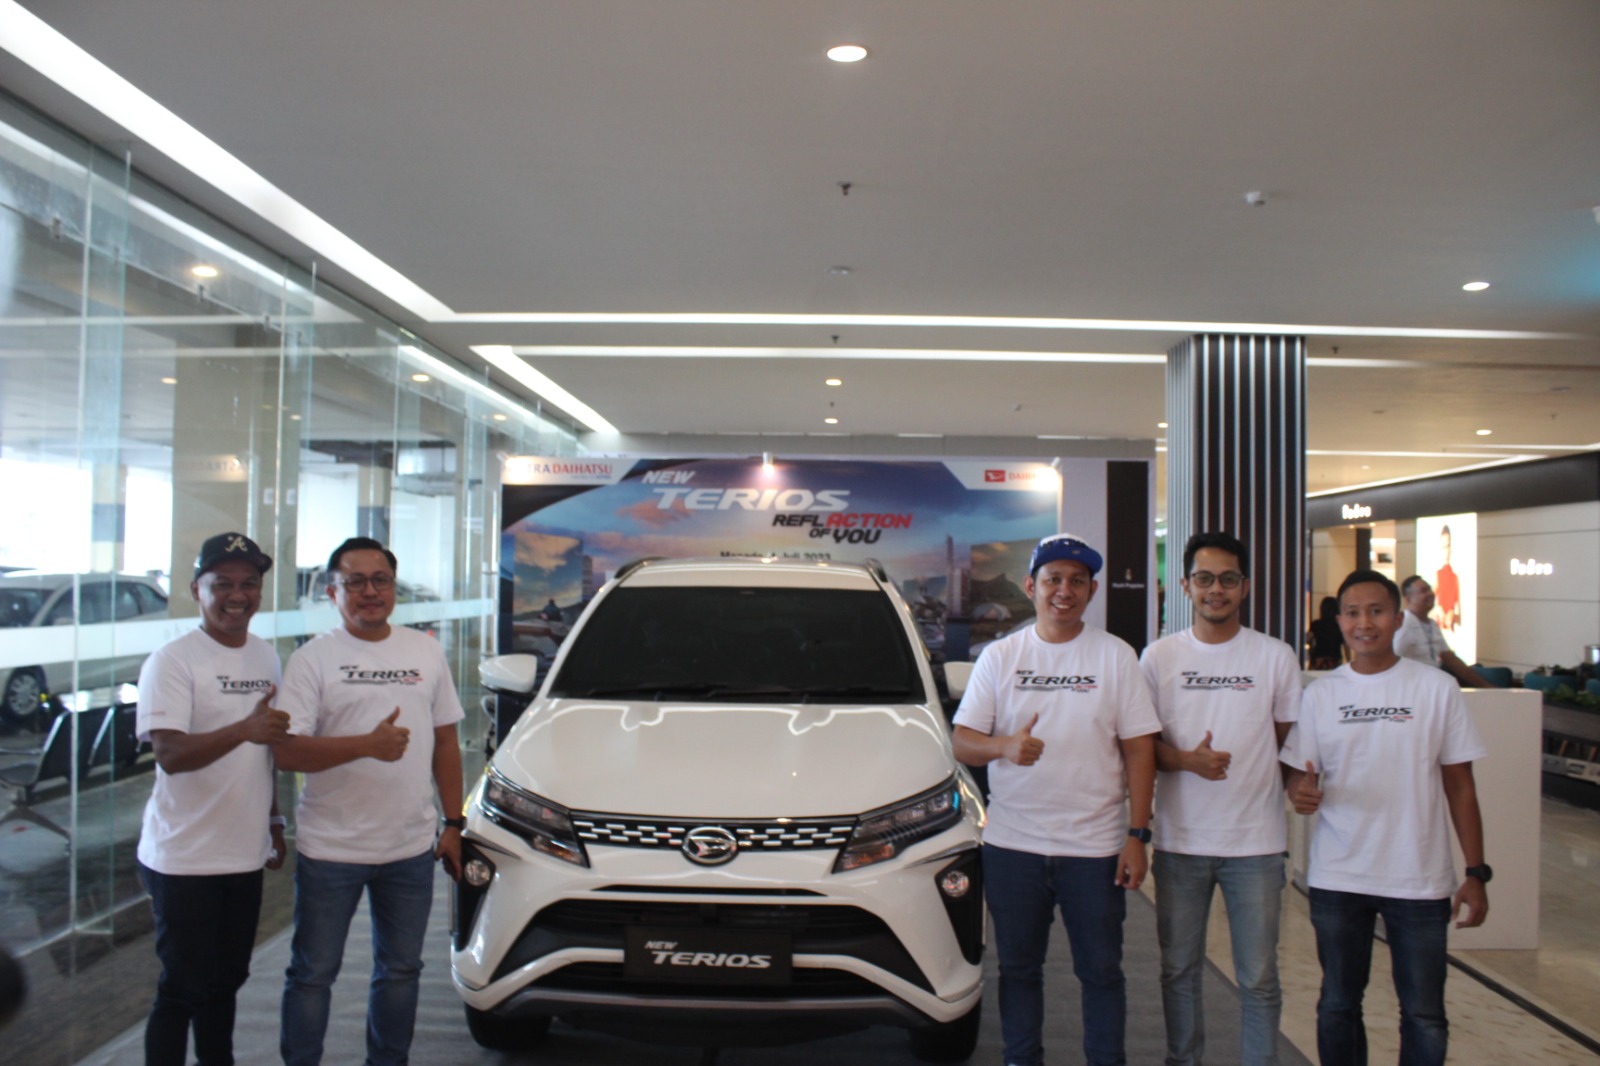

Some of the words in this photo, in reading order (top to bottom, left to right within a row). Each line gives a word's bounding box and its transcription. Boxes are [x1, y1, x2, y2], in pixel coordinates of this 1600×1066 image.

[642, 470, 696, 484] NEW
[652, 488, 850, 512] TERIOS
[809, 528, 831, 538] OF
[832, 529, 882, 544] YOU
[343, 669, 420, 679] TERIOS
[1019, 675, 1096, 685] TERIOS
[1184, 676, 1254, 685] TERIOS
[1341, 707, 1412, 719] TERIOS
[645, 941, 679, 950] NEW
[652, 951, 772, 969] TERIOS
